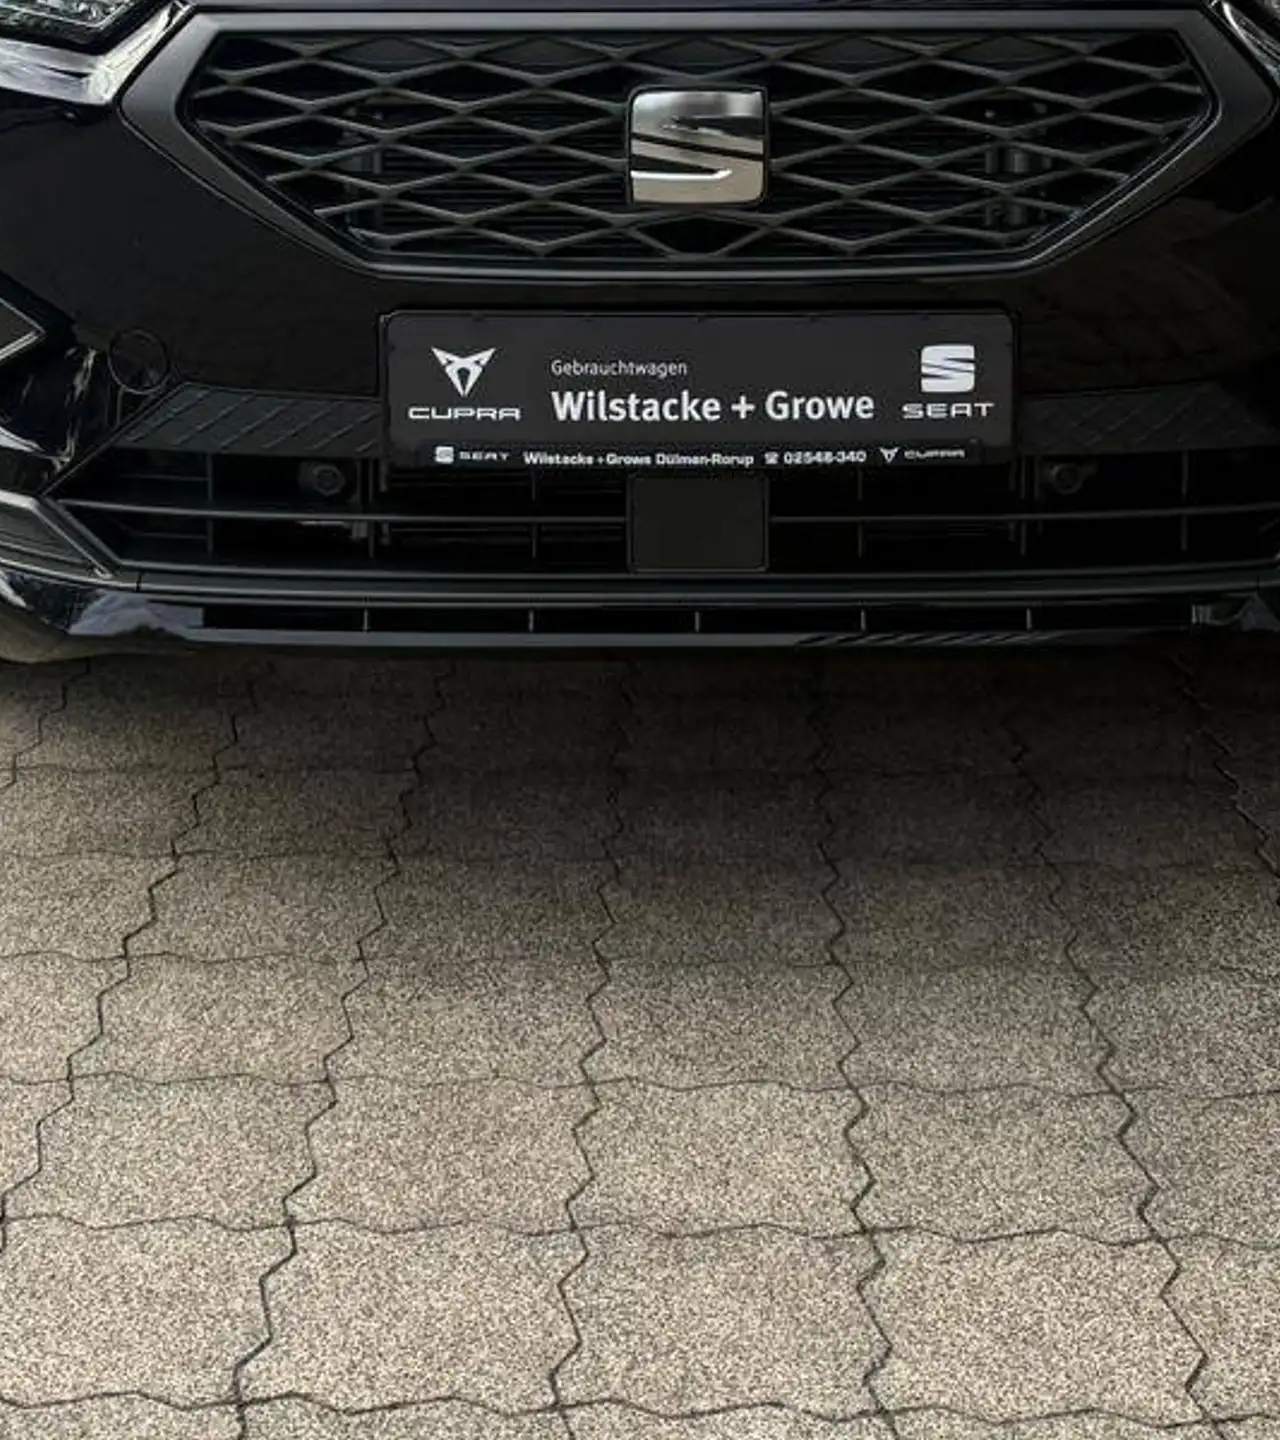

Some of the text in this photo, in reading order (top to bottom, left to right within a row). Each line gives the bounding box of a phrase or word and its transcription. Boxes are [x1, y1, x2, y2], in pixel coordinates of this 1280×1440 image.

[550, 360, 689, 378] Gebrauchtwagen
[408, 407, 521, 421] CUPRA
[550, 389, 721, 422] Wilstacke
[765, 390, 875, 421] Growe
[902, 402, 995, 419] SEAT
[524, 451, 594, 465] Wilstacke
[606, 453, 651, 465] Growe
